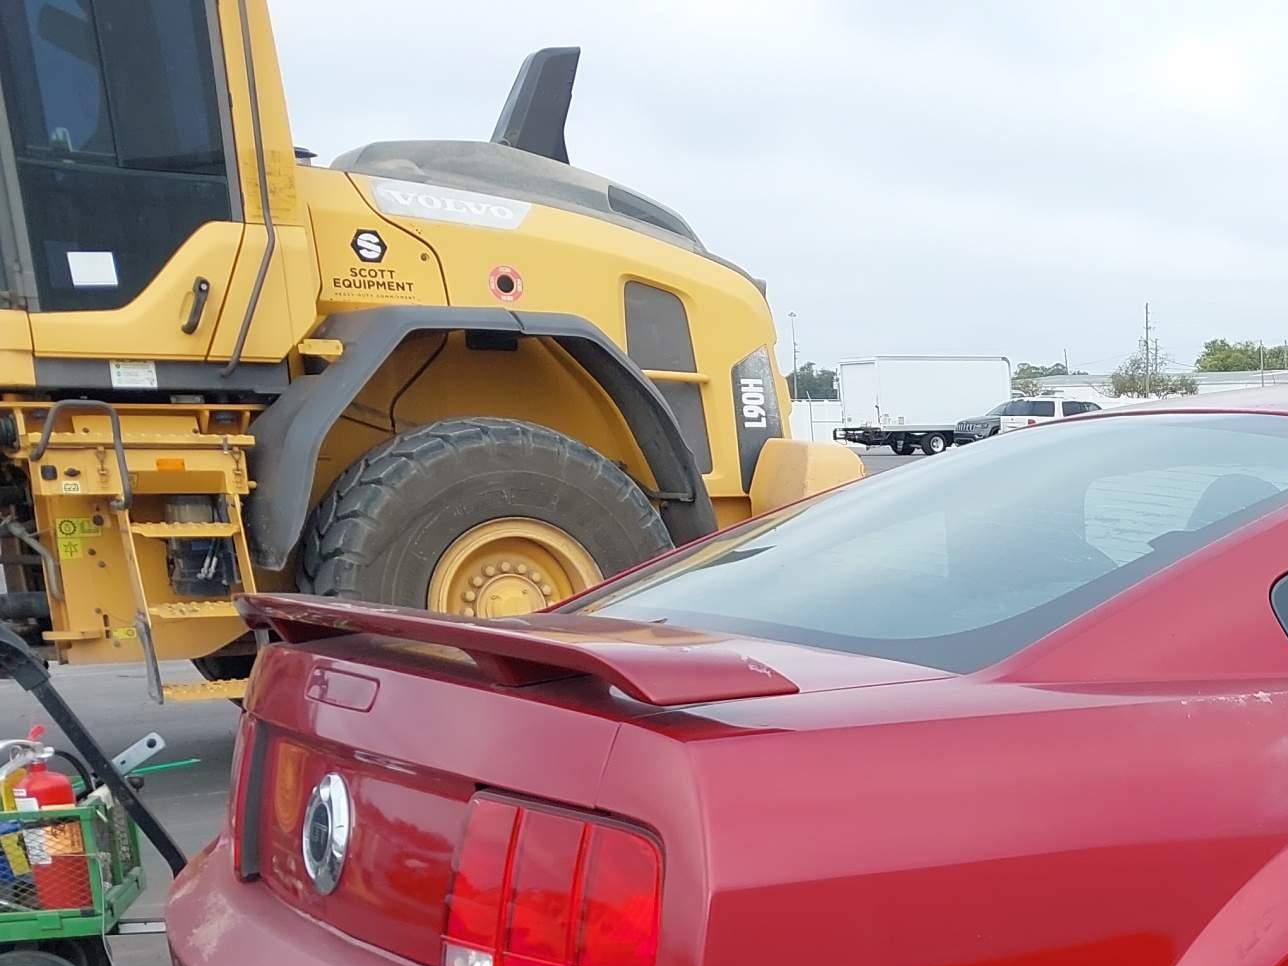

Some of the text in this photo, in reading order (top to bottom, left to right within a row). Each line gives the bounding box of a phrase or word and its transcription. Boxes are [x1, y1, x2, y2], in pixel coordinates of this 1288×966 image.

[386, 190, 513, 219] VOLVO
[350, 267, 396, 280] SCOTT
[333, 278, 414, 292] EQUIPMENT
[740, 378, 767, 428] L90H
